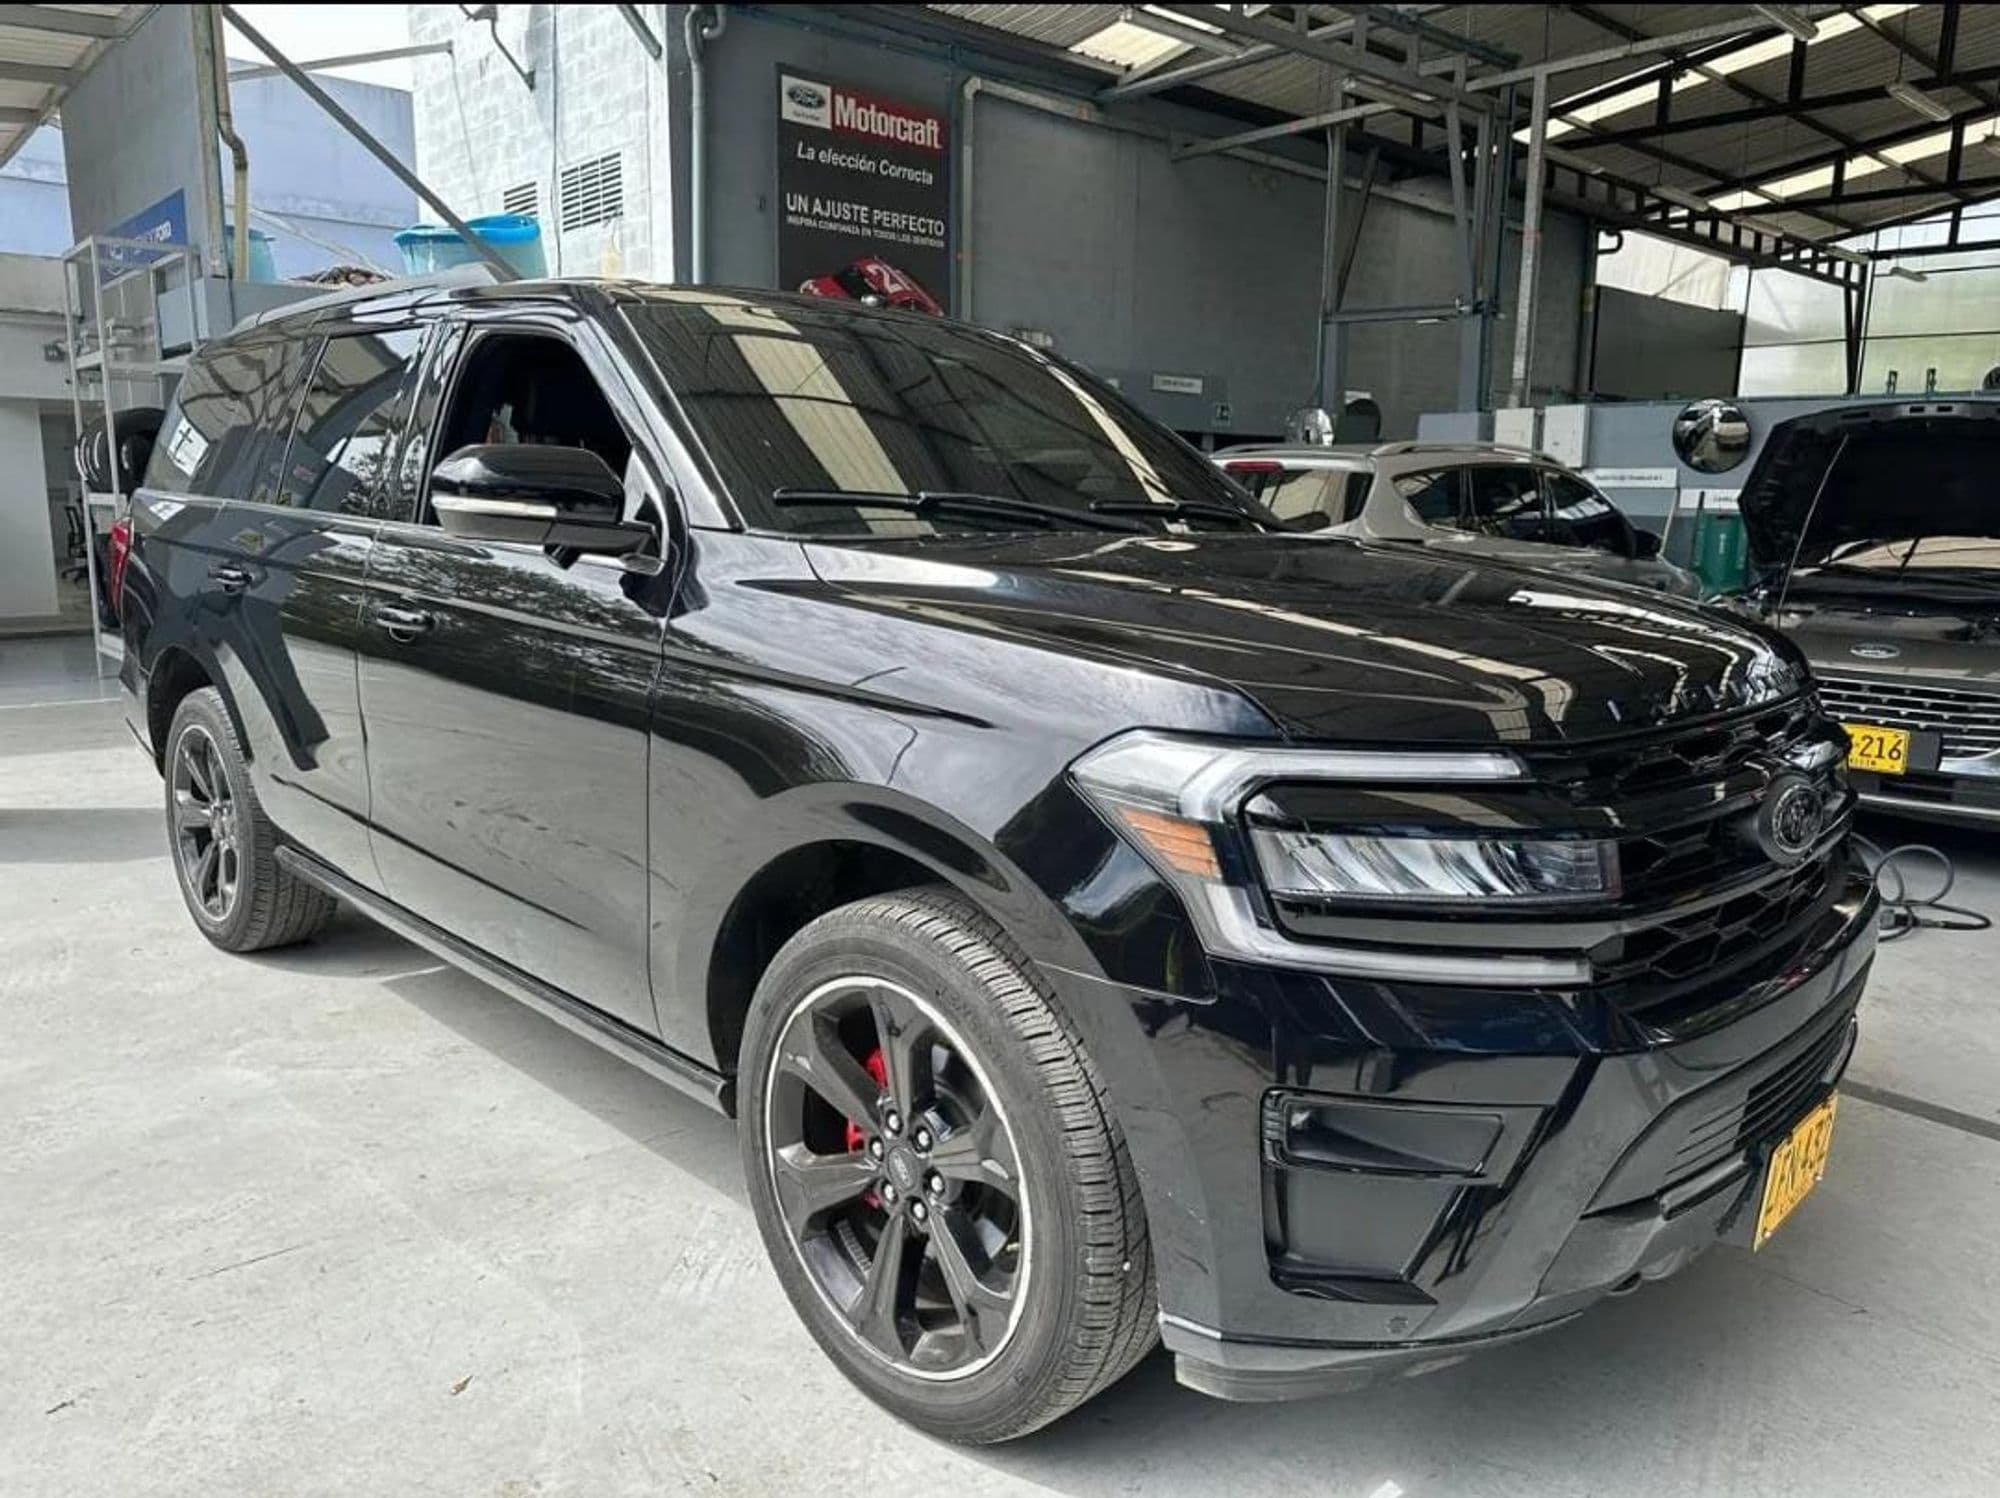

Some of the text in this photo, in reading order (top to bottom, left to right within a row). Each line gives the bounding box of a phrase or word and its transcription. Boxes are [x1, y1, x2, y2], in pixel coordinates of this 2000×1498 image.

[834, 94, 943, 149] Motorcraft
[797, 141, 933, 184] La elección Correcta
[786, 192, 945, 237] UN AJUSTE PERFECTO
